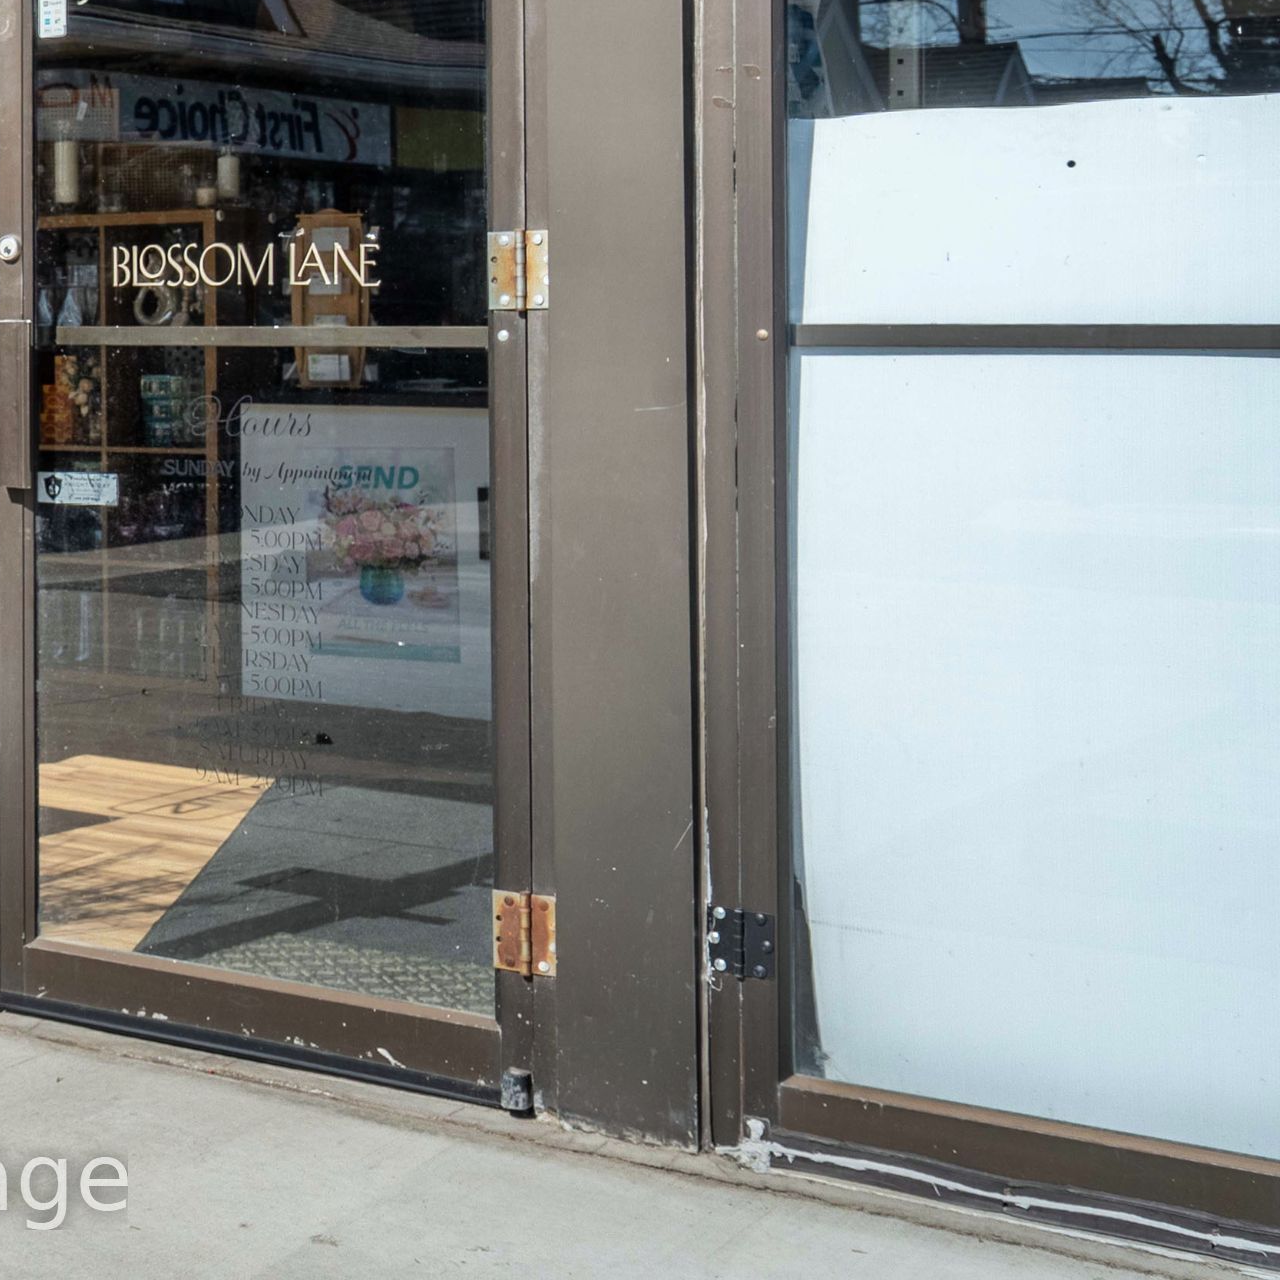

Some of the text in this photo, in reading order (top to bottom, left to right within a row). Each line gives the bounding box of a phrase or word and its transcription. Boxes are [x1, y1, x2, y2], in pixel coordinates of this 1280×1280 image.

[112, 241, 382, 288] BLOSSOM LANE
[162, 458, 236, 477] SUNDAY
